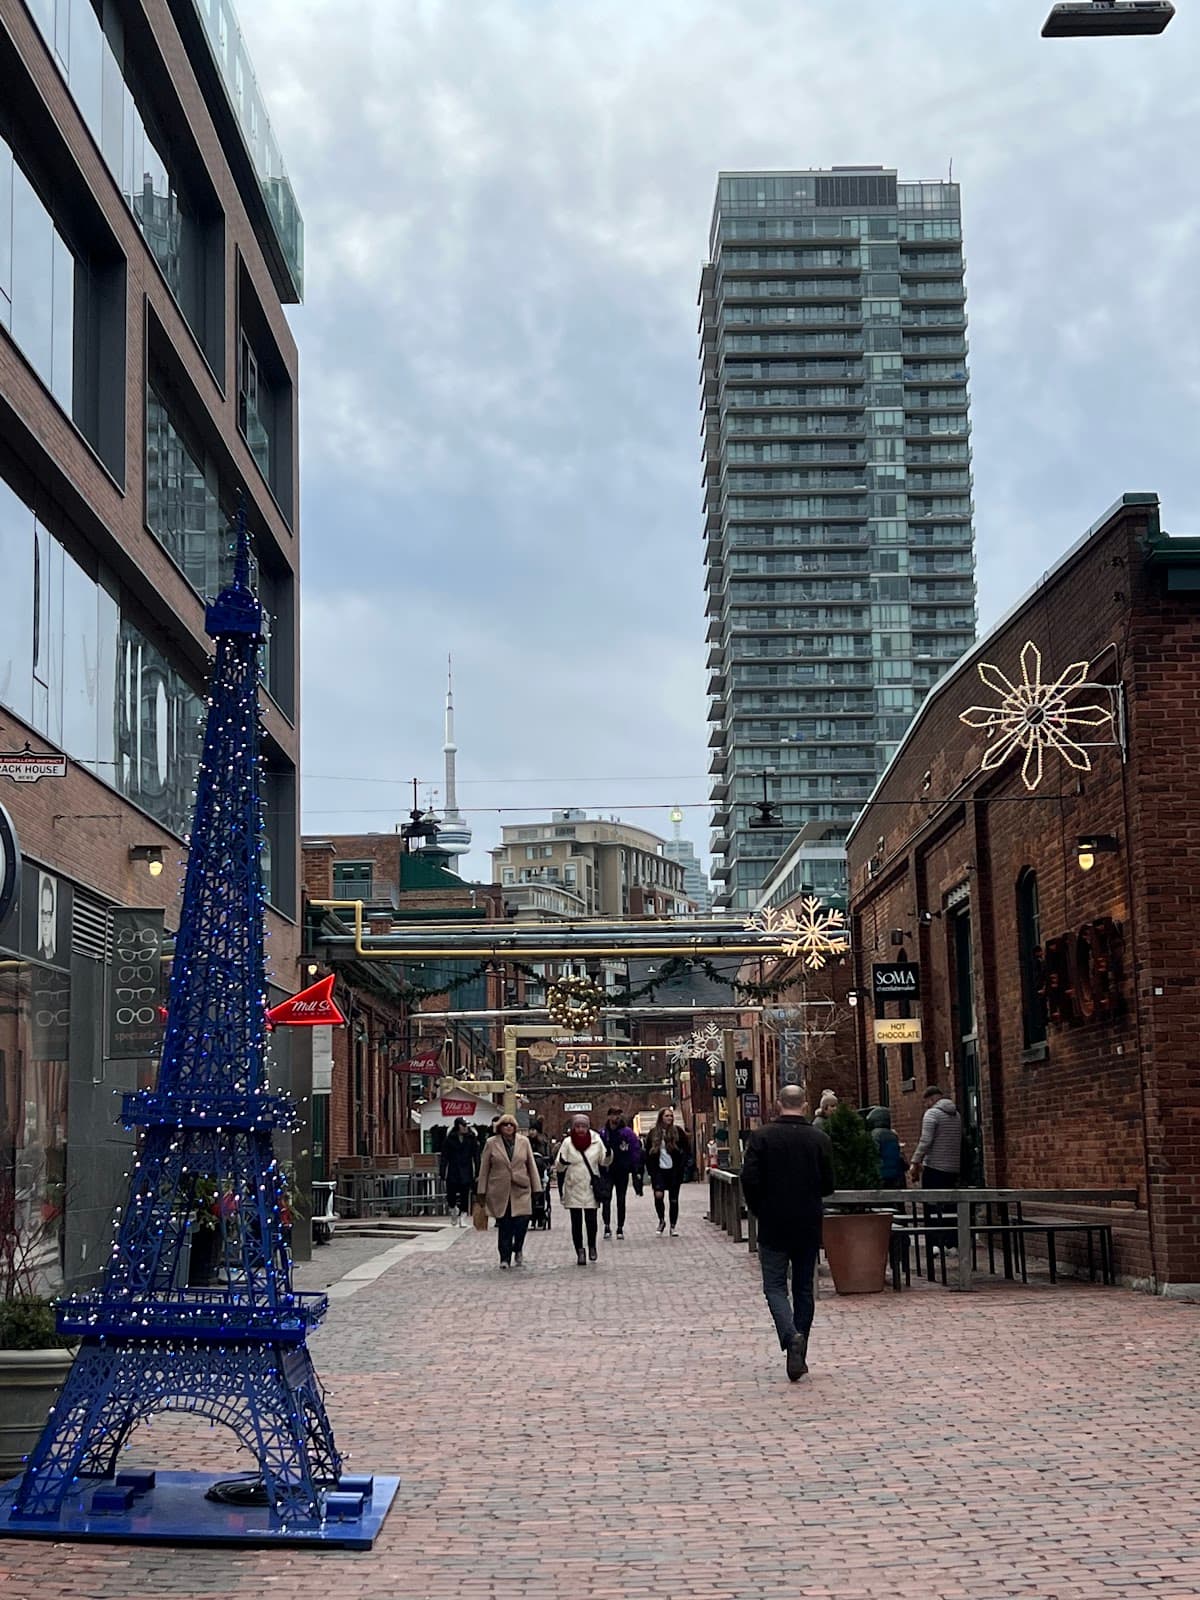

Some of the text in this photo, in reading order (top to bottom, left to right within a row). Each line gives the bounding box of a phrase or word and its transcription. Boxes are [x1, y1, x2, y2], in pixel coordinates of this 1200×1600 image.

[0, 764, 59, 774] ACK HOUSE
[291, 1000, 319, 1012] Mill
[891, 1023, 906, 1031] HOT
[877, 1031, 920, 1039] CHOCOLATE
